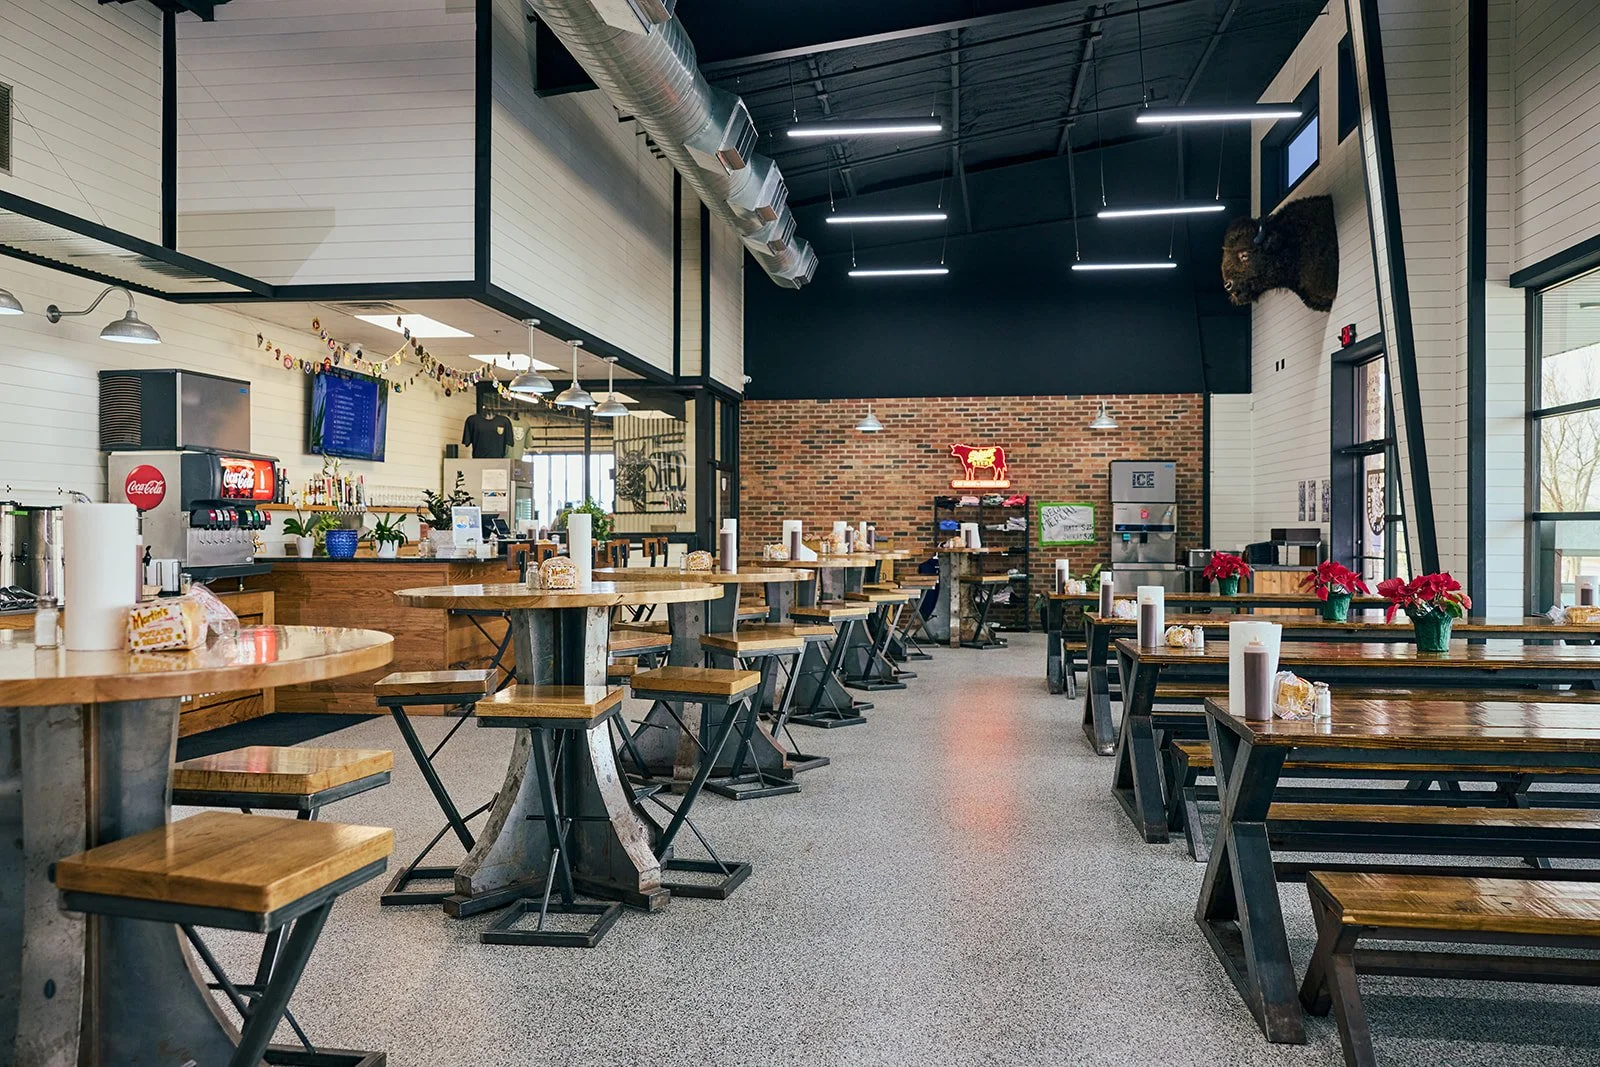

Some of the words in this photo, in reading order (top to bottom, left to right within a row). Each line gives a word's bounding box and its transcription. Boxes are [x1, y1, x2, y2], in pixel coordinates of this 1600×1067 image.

[649, 452, 686, 491] SHED
[1132, 473, 1154, 486] ICE
[127, 480, 164, 495] Coca-Cola
[1042, 506, 1062, 519] NEW
[131, 608, 168, 630] Martin's
